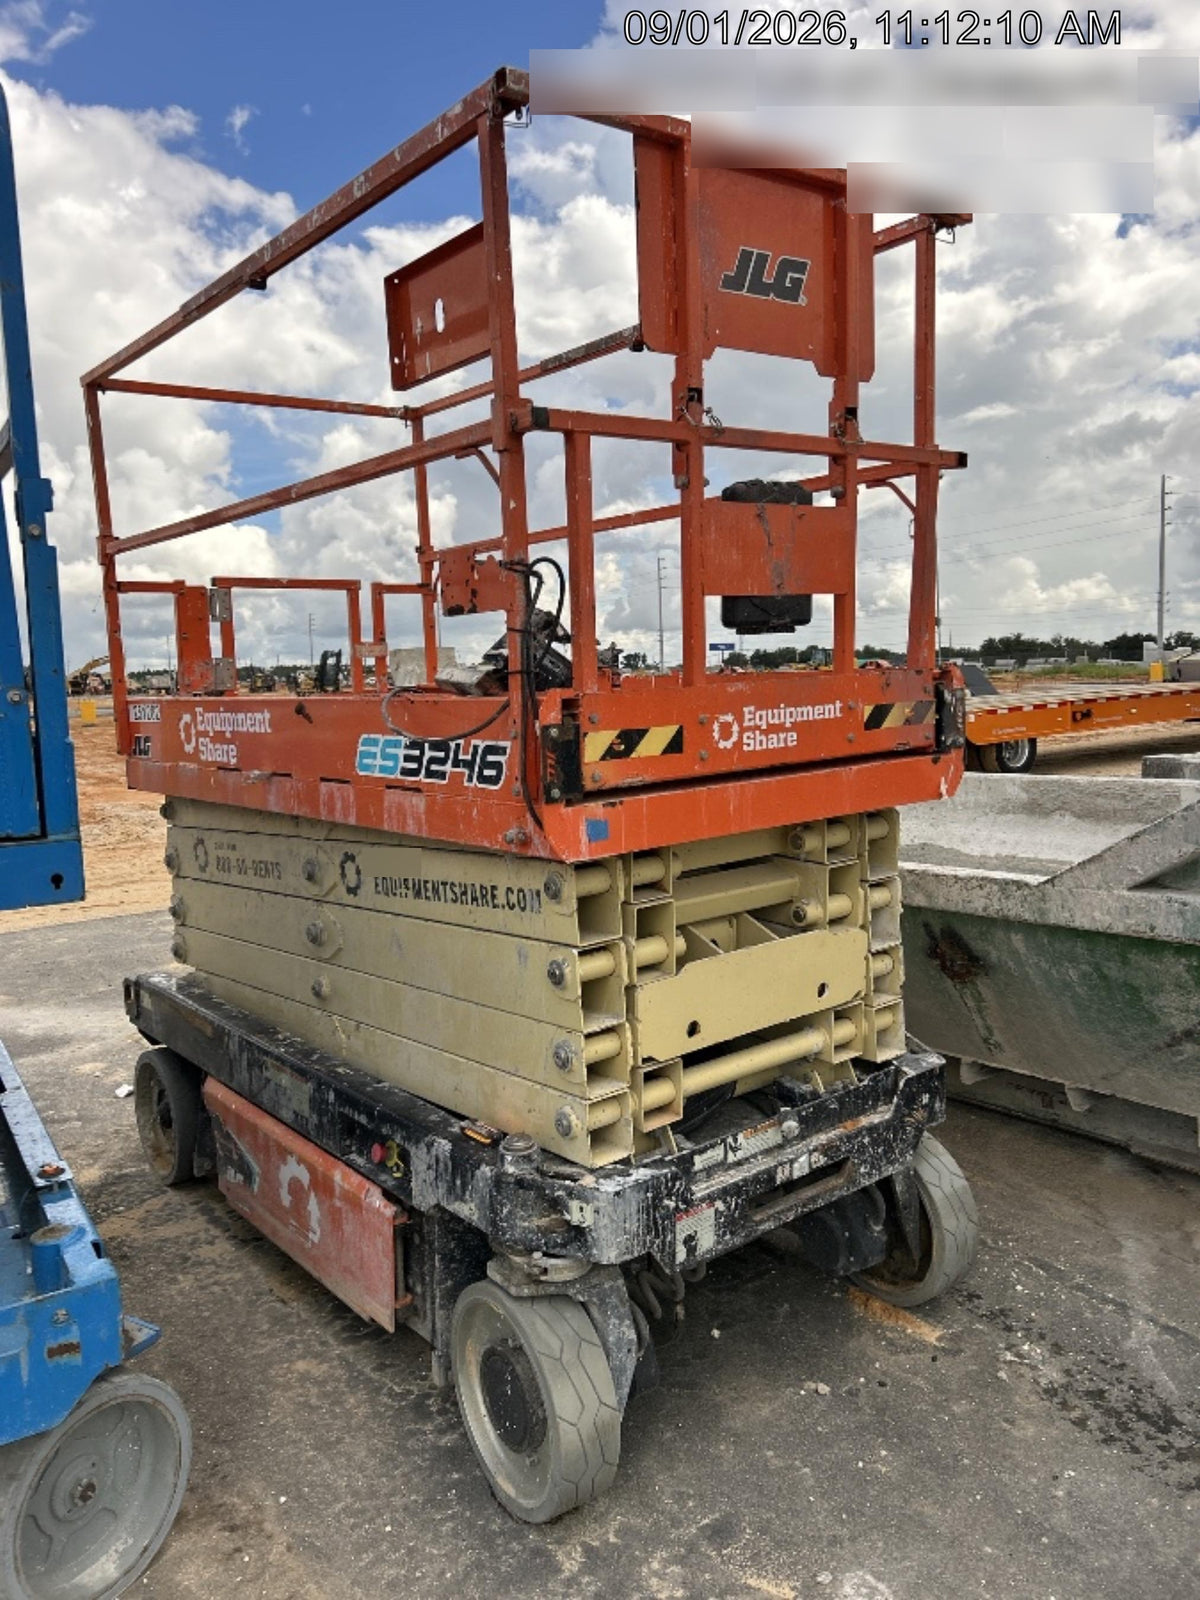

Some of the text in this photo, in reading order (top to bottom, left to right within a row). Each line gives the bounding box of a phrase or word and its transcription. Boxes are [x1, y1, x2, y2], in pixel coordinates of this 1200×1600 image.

[718, 247, 811, 304] JLG
[195, 707, 272, 738] Equipment
[743, 700, 843, 729] Equipment
[198, 737, 237, 765] Share
[743, 730, 798, 751] Share
[356, 734, 511, 789] ES3246
